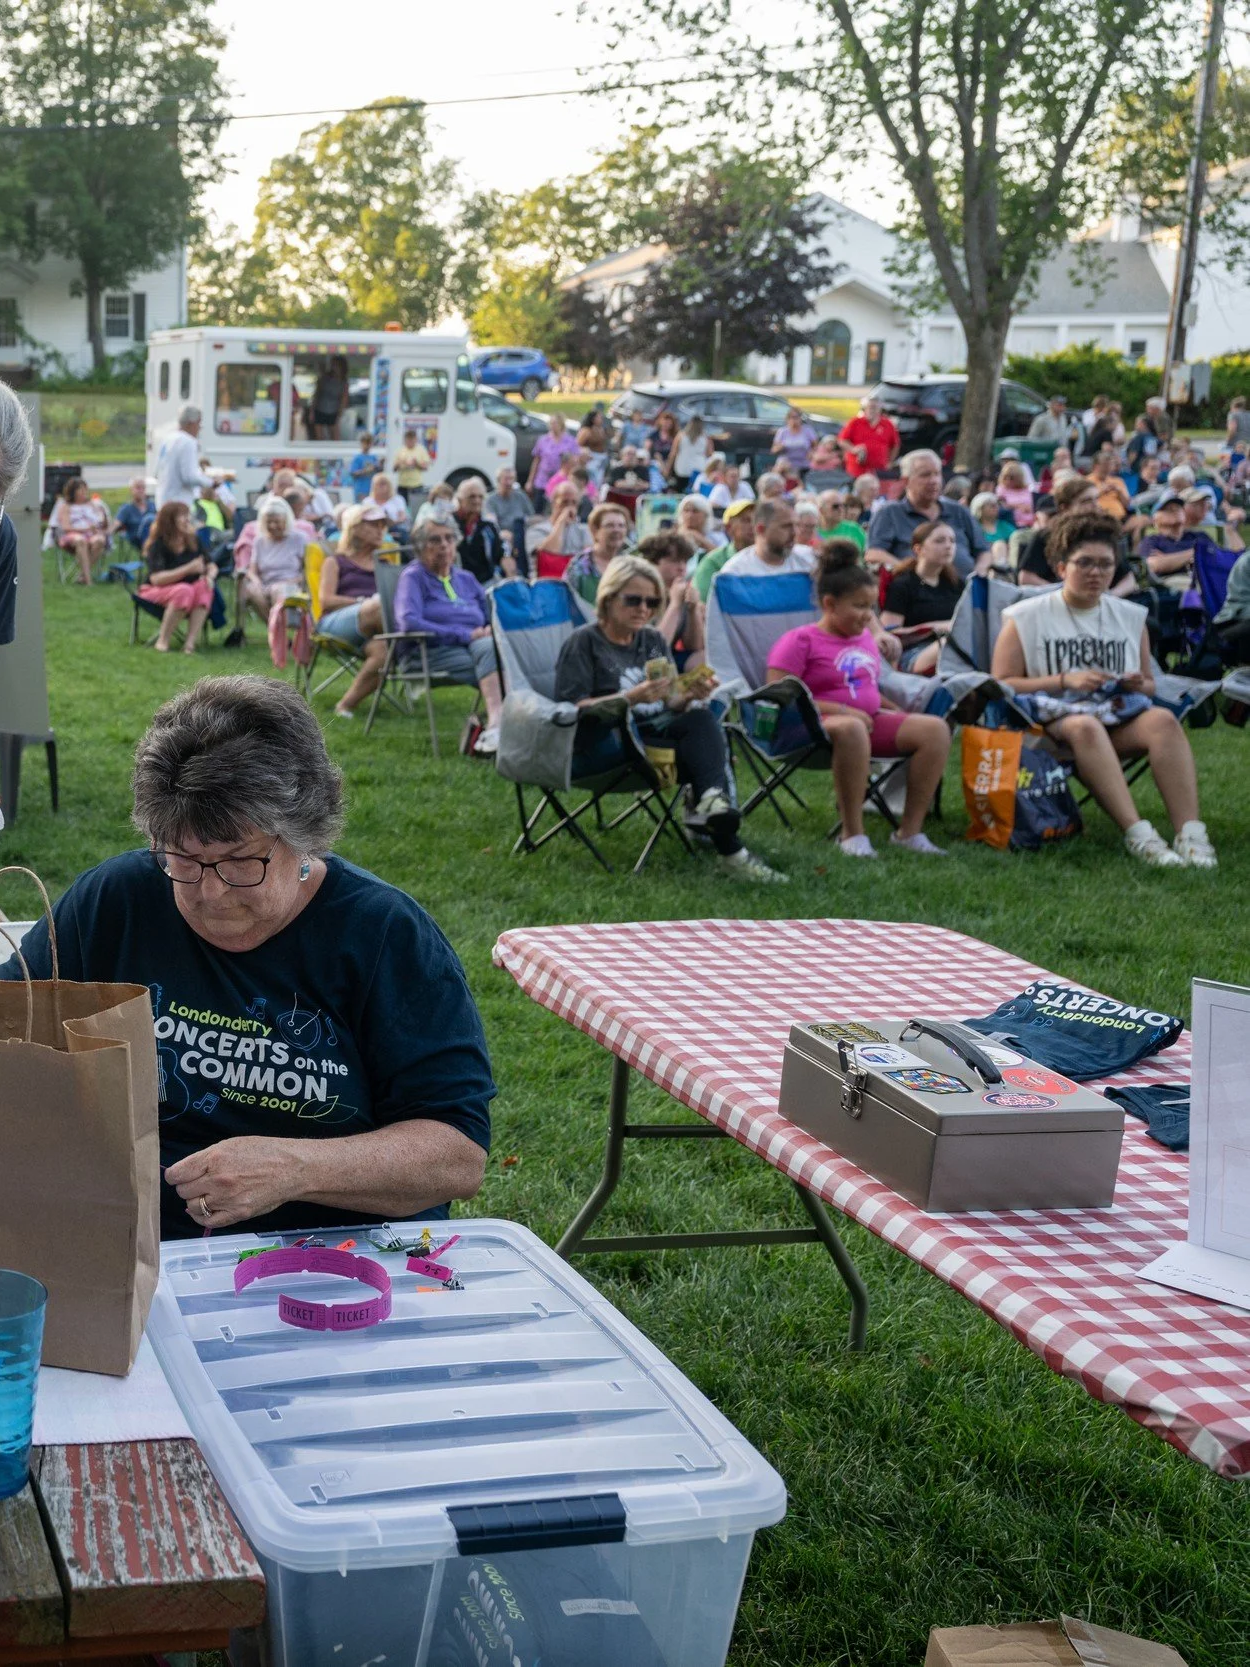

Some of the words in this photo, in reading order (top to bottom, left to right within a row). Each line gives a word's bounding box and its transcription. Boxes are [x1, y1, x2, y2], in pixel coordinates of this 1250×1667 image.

[169, 1000, 273, 1037] Londonderry
[1036, 1005, 1146, 1034] Londonderry
[153, 1015, 290, 1065] ONCERTS
[294, 1056, 317, 1071] on
[321, 1059, 349, 1076] the
[180, 1050, 328, 1102] COMMON
[260, 1096, 297, 1113] 2001
[282, 1302, 314, 1321] TICKET
[336, 1308, 370, 1323] TICKET
